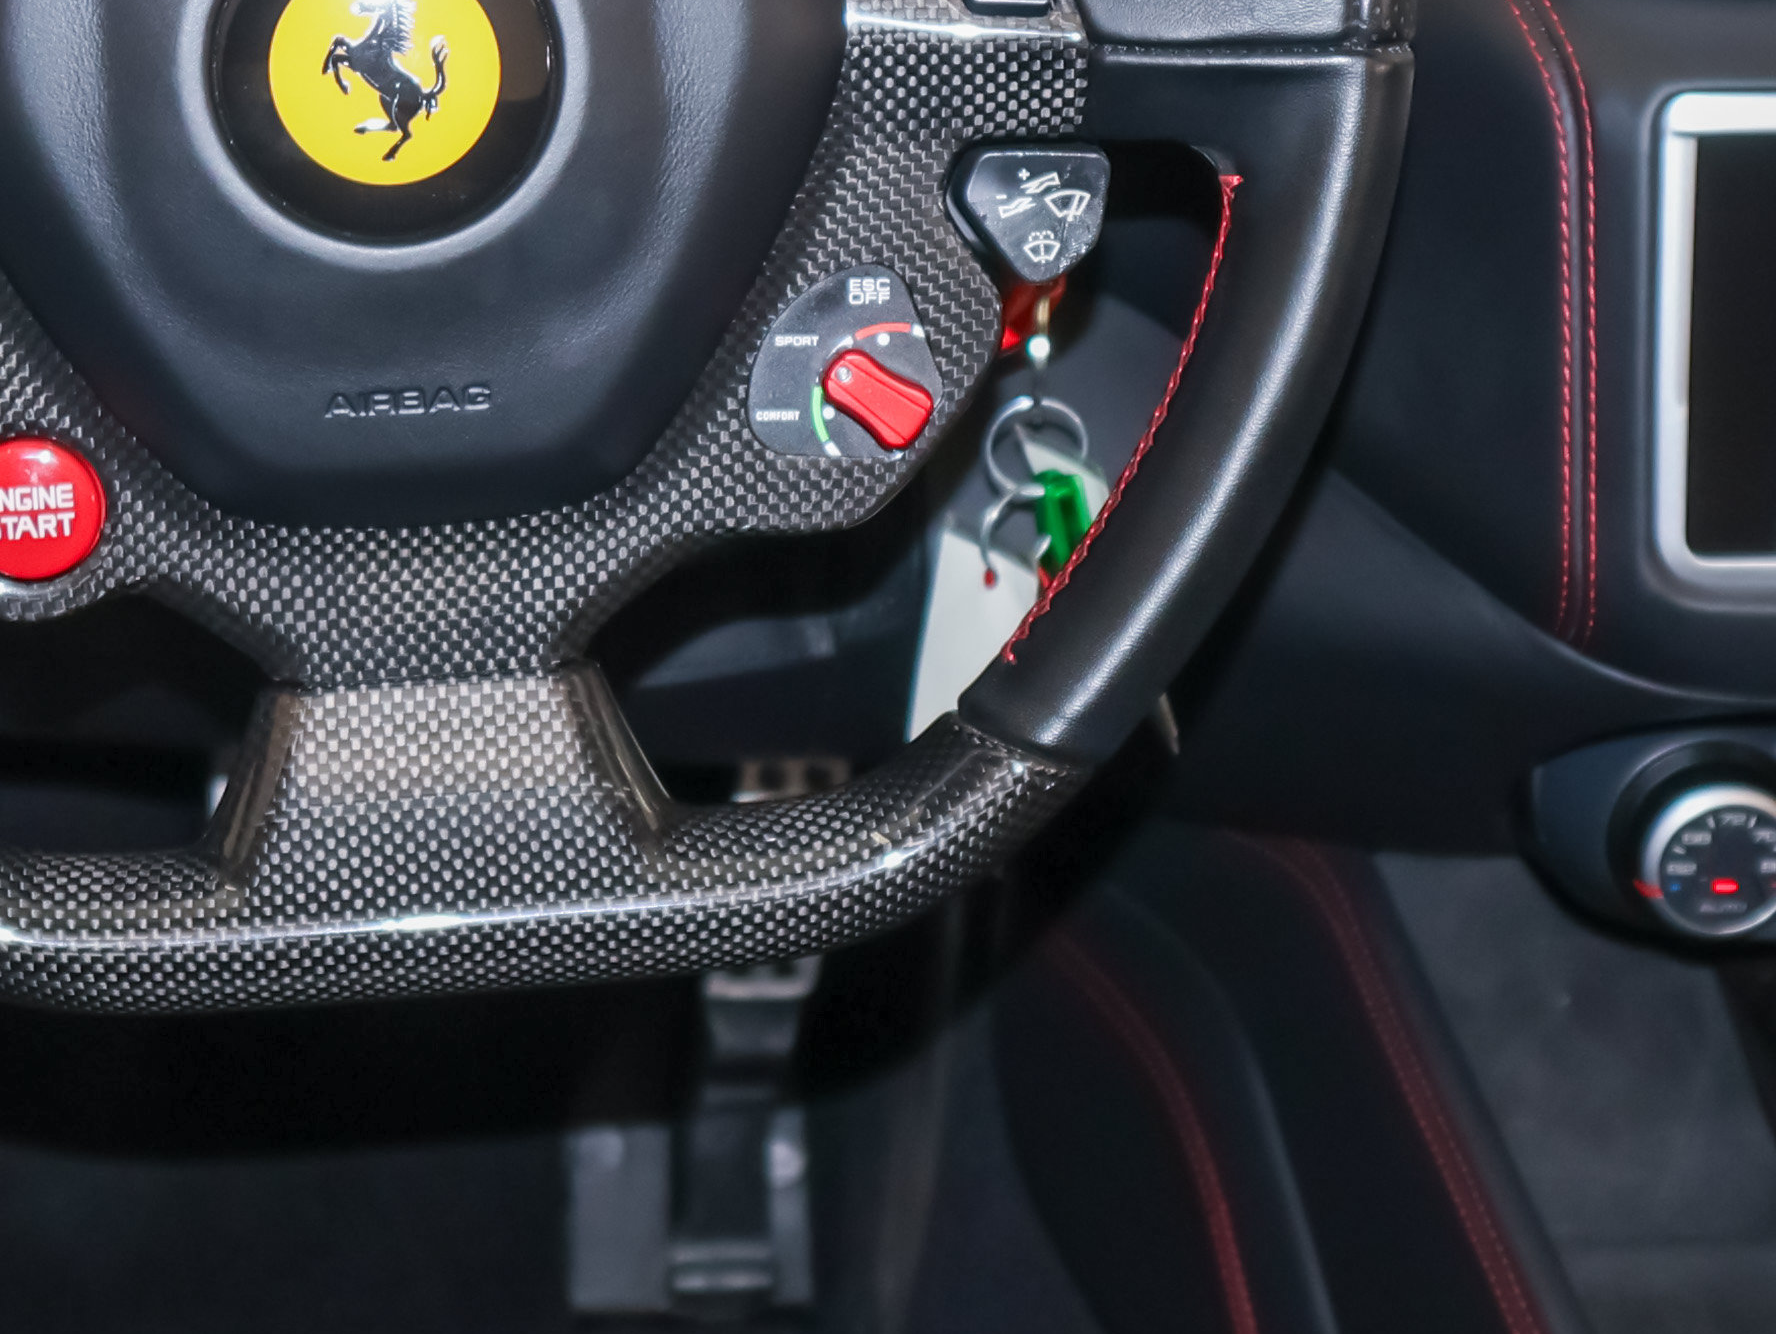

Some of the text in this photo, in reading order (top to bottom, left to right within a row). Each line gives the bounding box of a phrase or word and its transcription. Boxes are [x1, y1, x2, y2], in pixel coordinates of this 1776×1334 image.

[847, 277, 891, 292] ESC
[847, 291, 891, 305] OFF
[774, 334, 820, 347] SPORT
[324, 386, 492, 419] AIRBAG
[755, 409, 801, 422] COMFORT
